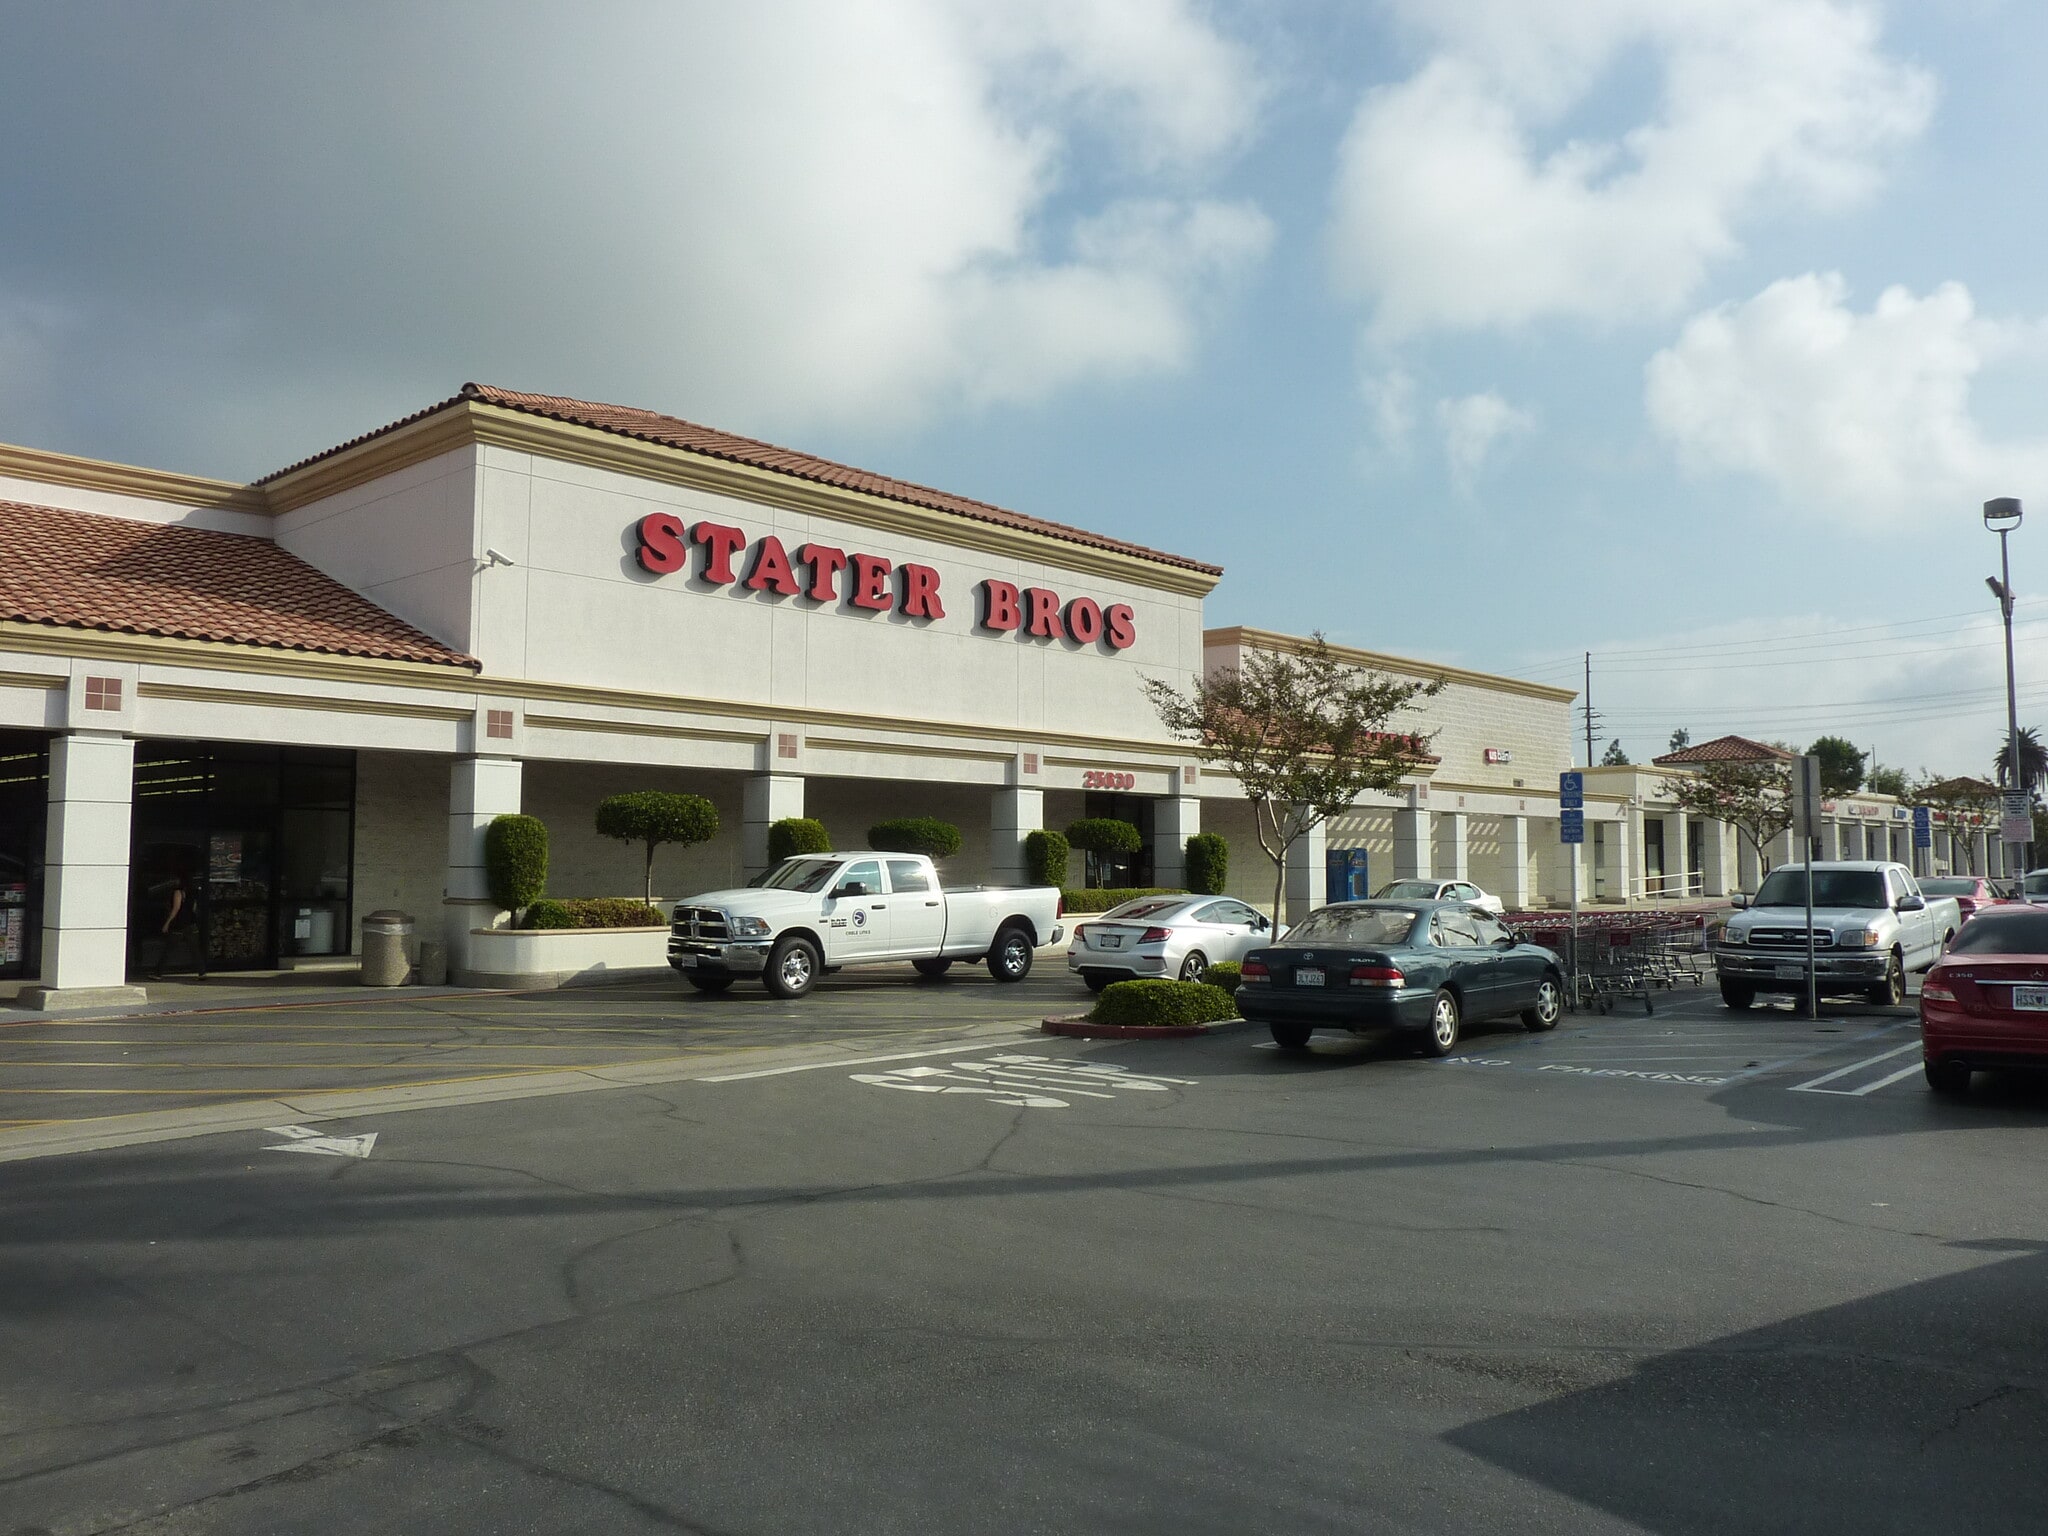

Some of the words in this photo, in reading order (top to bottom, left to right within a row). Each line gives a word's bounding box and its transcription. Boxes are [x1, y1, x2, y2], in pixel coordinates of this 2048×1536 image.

[635, 512, 946, 620] STATER
[981, 578, 1136, 650] BROS
[1083, 771, 1135, 790] 25630
[848, 1054, 1200, 1108] STOP
[1445, 1056, 1511, 1066] NO
[1536, 1063, 1727, 1084] PARKING
